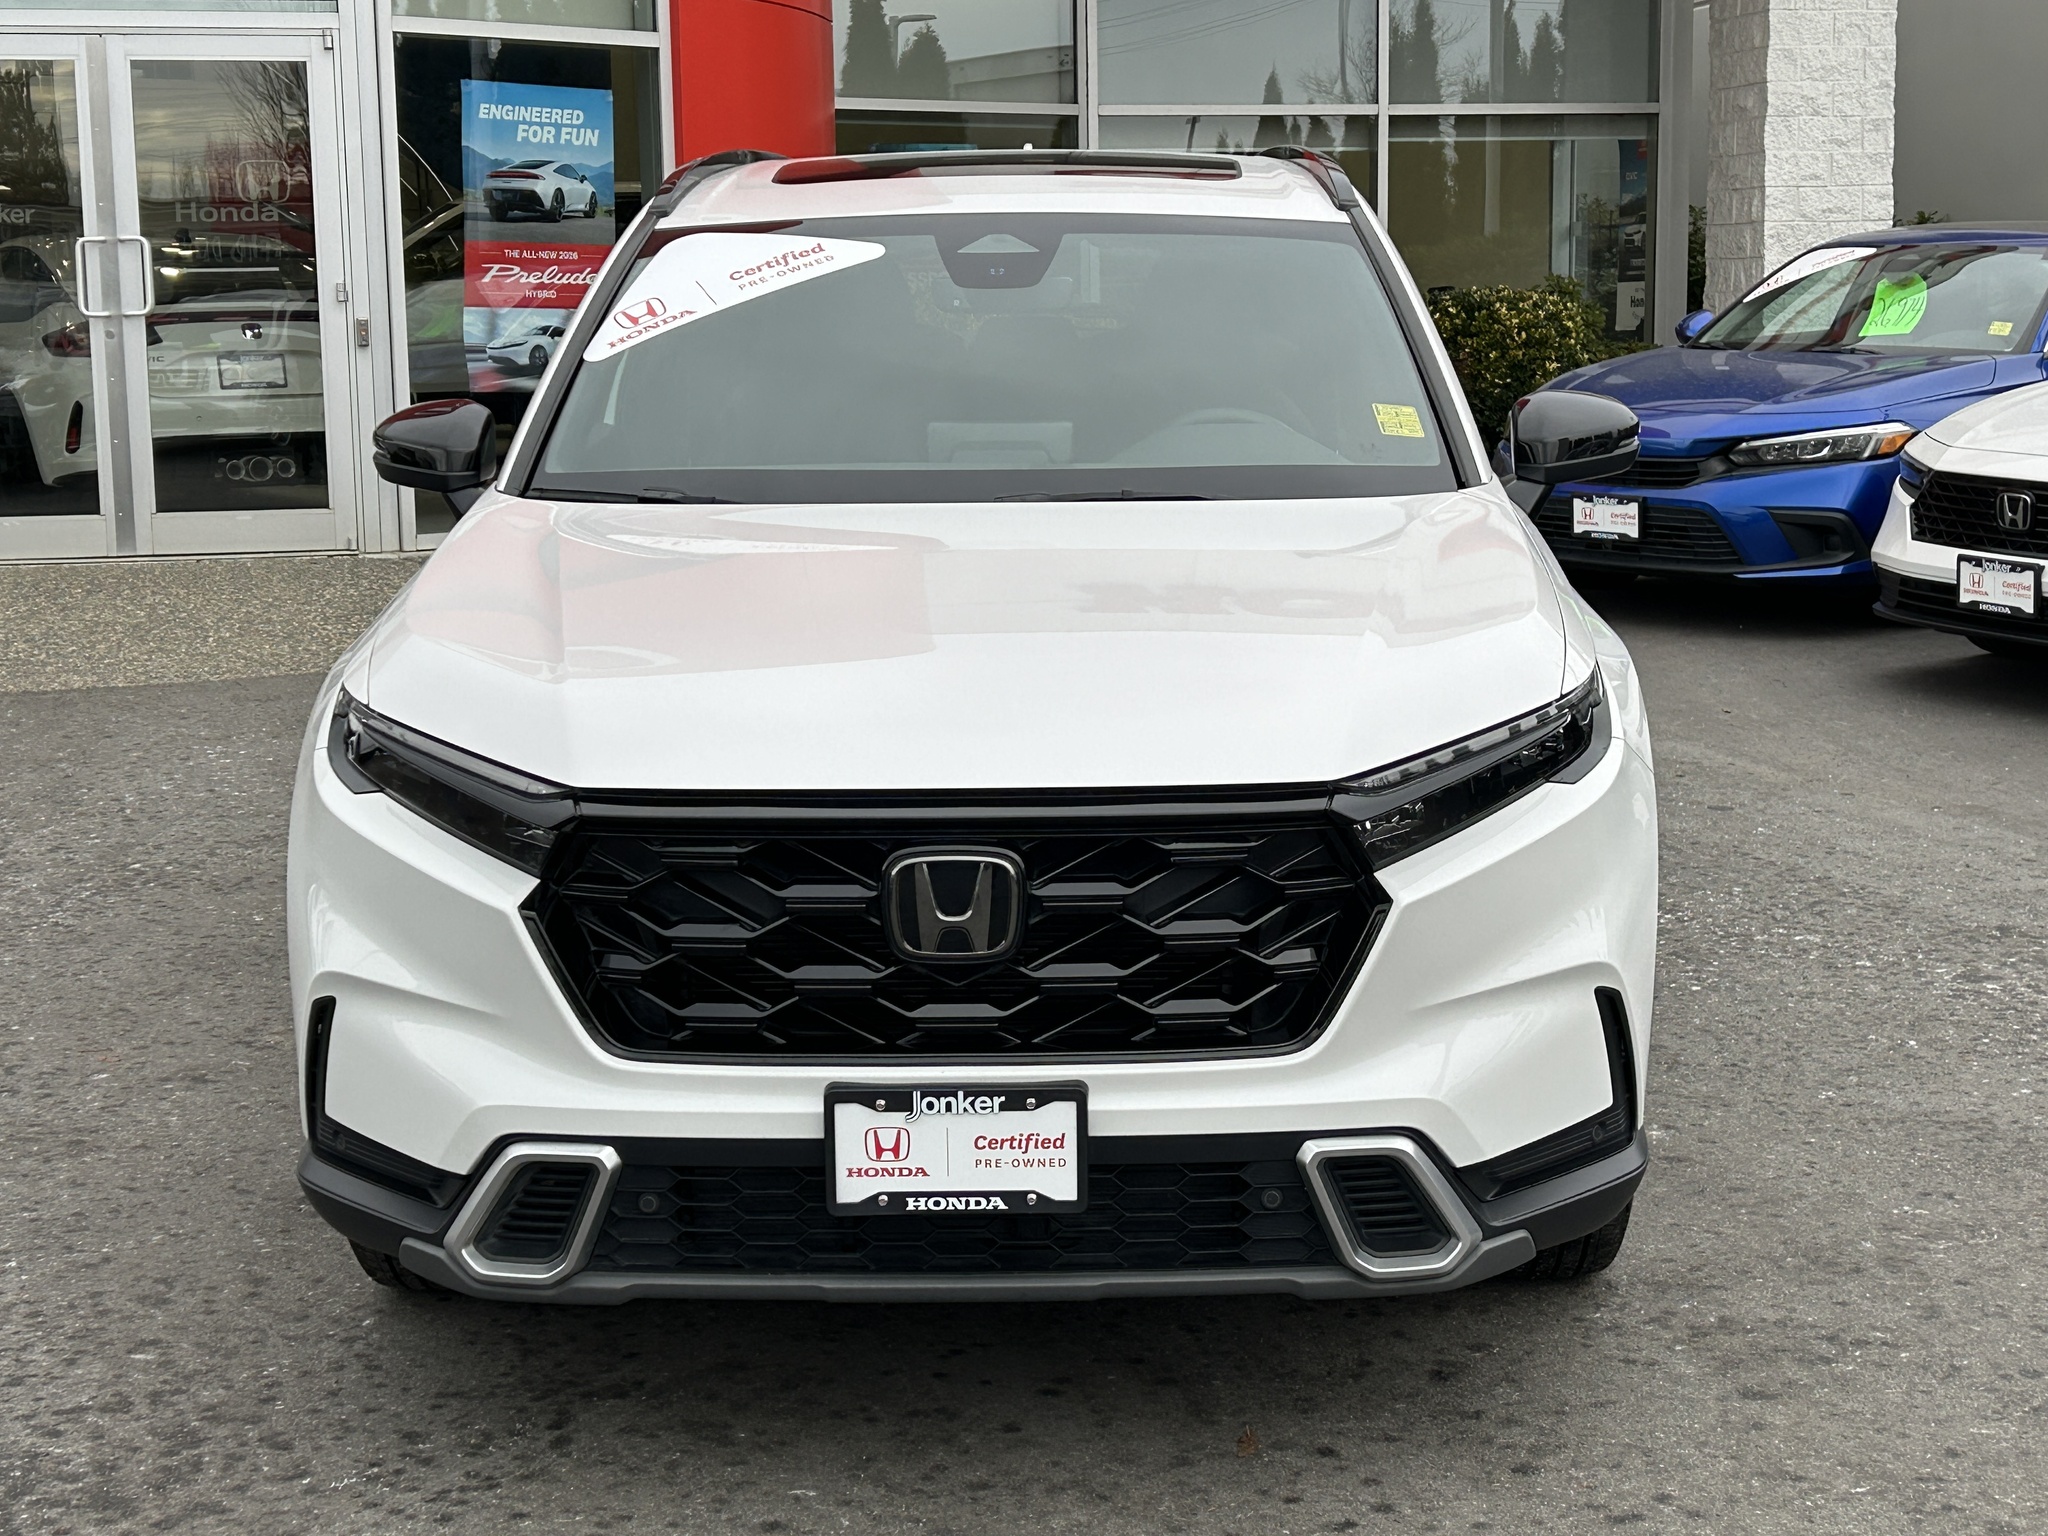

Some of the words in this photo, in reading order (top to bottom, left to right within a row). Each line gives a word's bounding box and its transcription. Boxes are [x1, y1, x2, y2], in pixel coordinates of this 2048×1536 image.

[478, 103, 585, 125] ENGINEERED
[516, 124, 556, 144] FOR
[560, 127, 600, 147] FUN
[174, 202, 279, 222] Honda
[504, 249, 520, 259] THE
[729, 243, 826, 281] Certified
[738, 255, 834, 291] PRE-OWNED
[607, 310, 698, 349] HONDA
[1982, 558, 2012, 573] Jonker
[1979, 603, 2012, 614] HONDA
[904, 1090, 1006, 1123] Jonker
[973, 1132, 1067, 1155] Certified
[845, 1167, 931, 1178] HONDA
[974, 1157, 1067, 1169] PRE-OWNED
[905, 1196, 1009, 1211] HONDA
